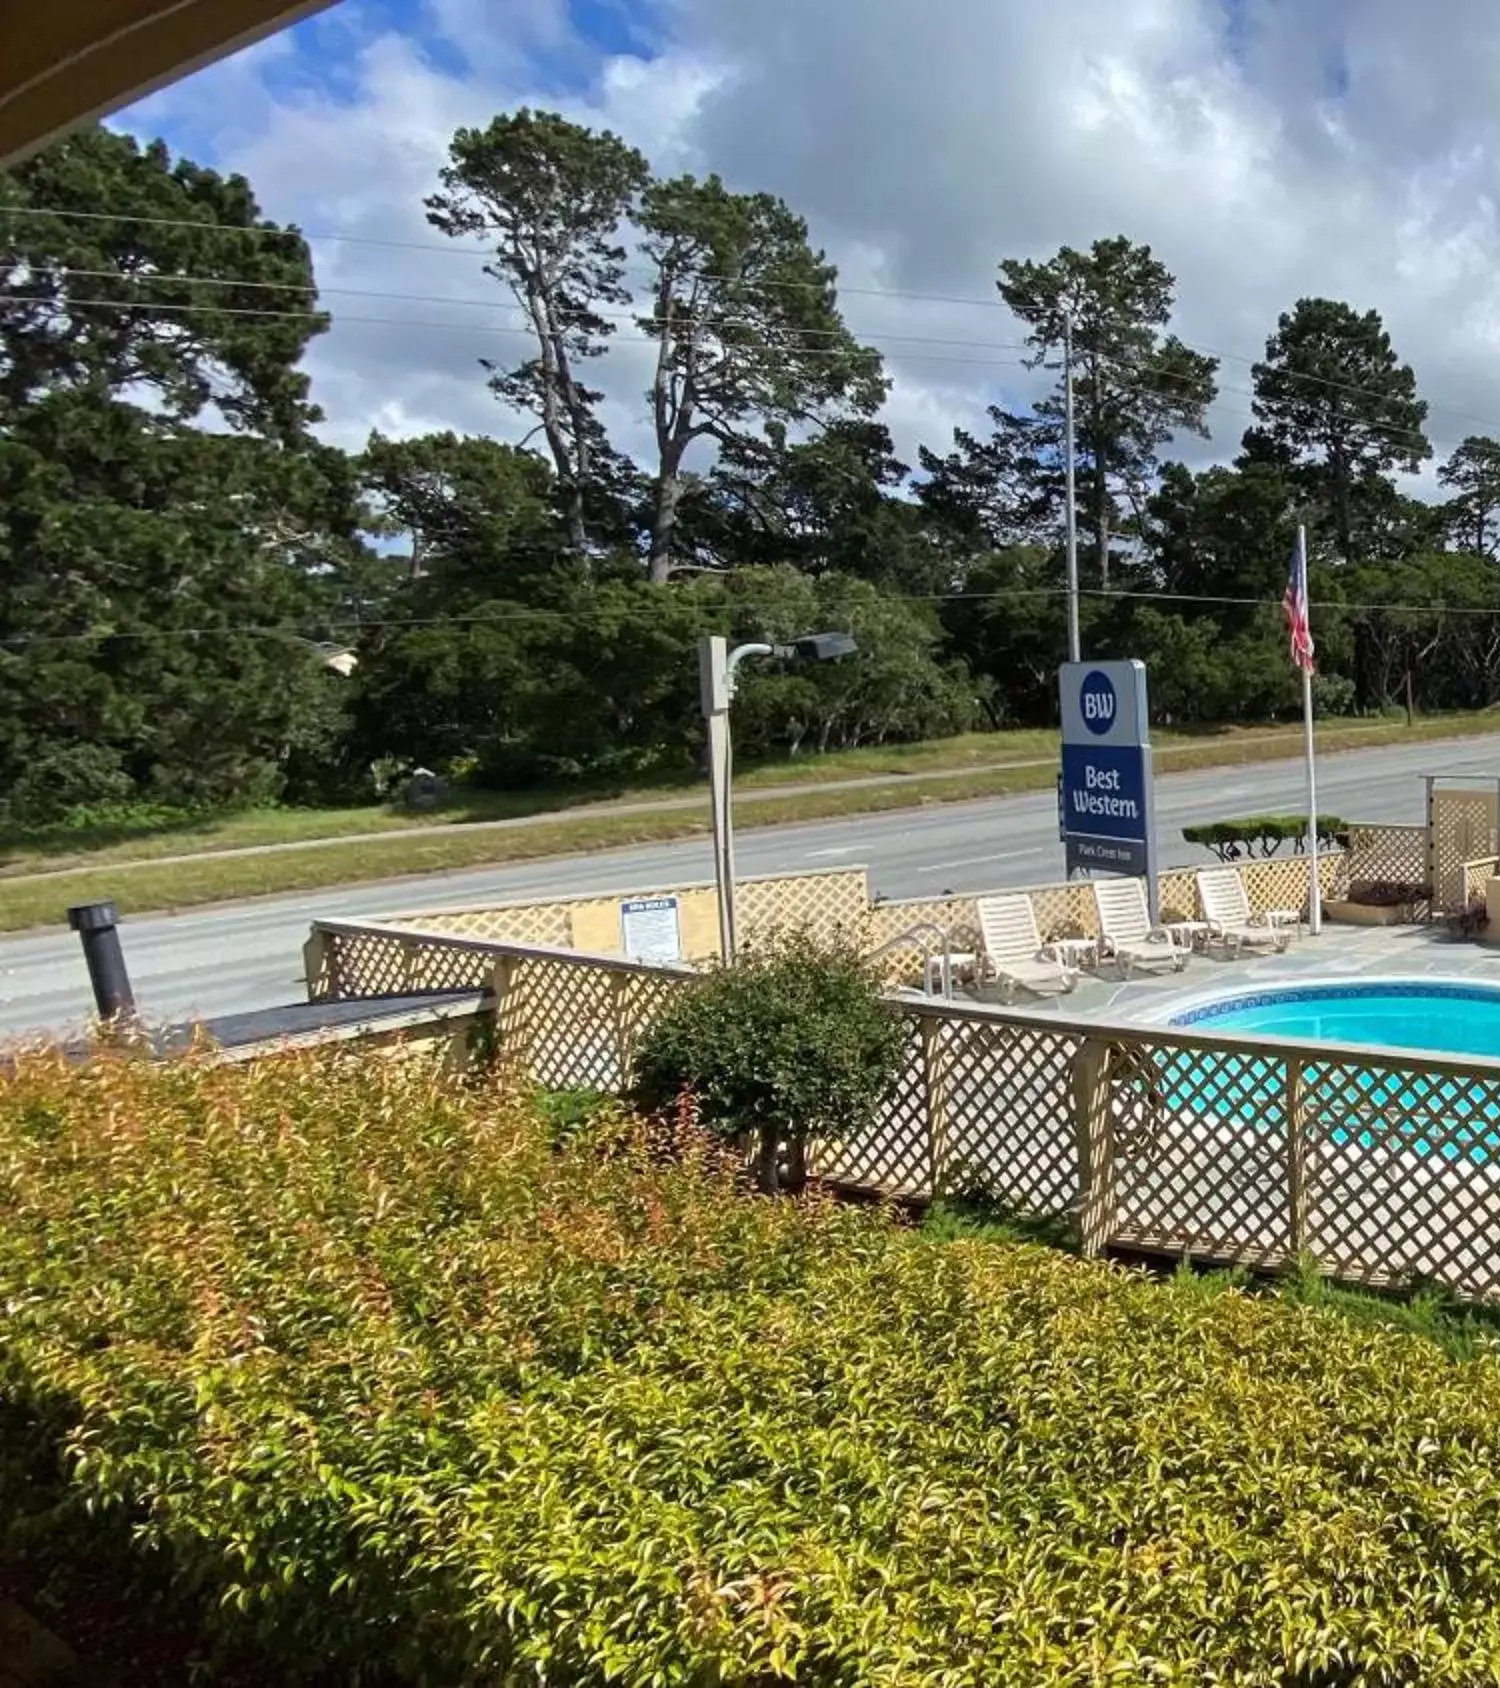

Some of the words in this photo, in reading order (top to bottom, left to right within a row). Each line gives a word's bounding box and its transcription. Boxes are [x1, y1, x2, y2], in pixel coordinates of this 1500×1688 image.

[1085, 692, 1113, 719] BW
[1085, 765, 1120, 790] Best
[1073, 789, 1139, 819] Western
